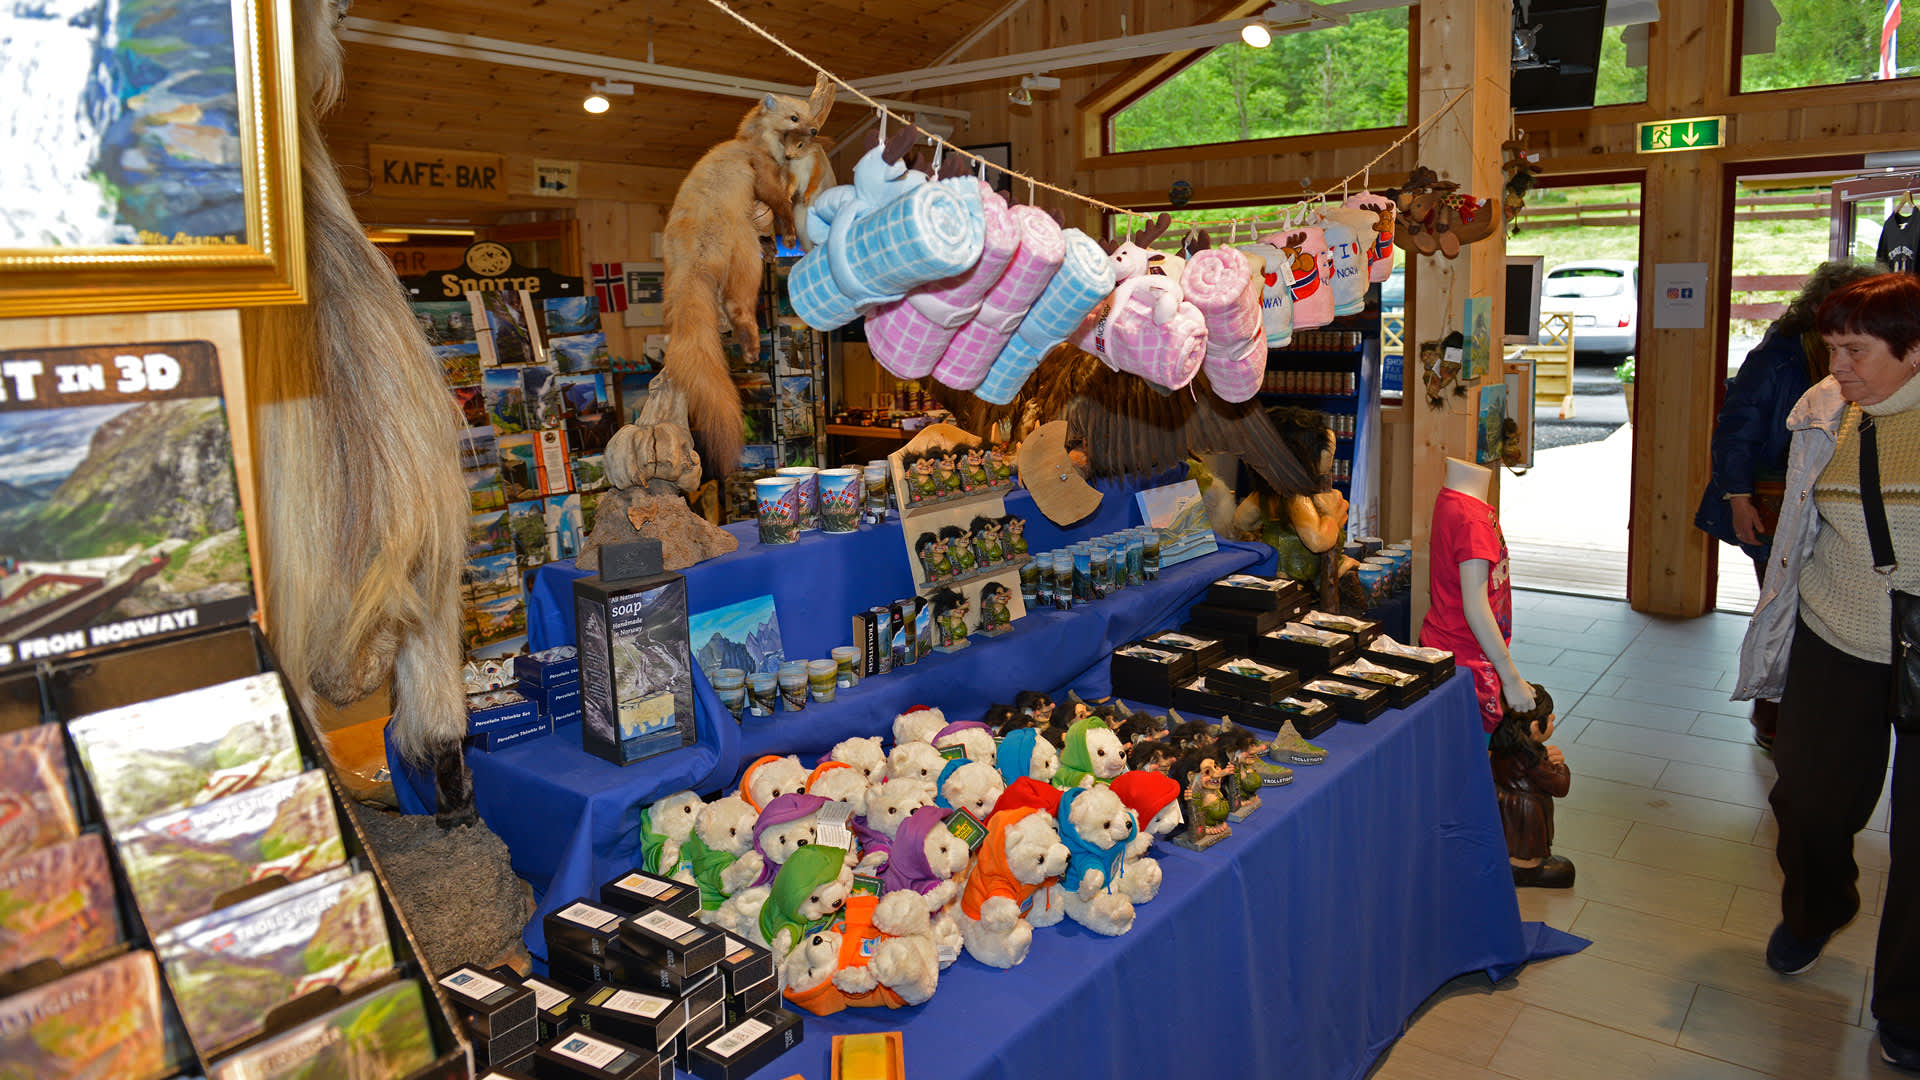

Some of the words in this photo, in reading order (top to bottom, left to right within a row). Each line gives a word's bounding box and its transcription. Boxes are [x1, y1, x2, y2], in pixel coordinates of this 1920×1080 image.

[456, 165, 497, 190] BAR
[393, 251, 426, 271] AR
[1339, 243, 1350, 259] I
[441, 273, 541, 298] Snorre
[1263, 296, 1283, 309] WAY
[0, 360, 43, 402] T
[55, 363, 106, 394] IN
[114, 352, 182, 394] 3D
[611, 601, 642, 617] soap
[612, 617, 642, 629] Handmade
[18, 629, 86, 661] FROM
[89, 608, 198, 646] NORWAY!
